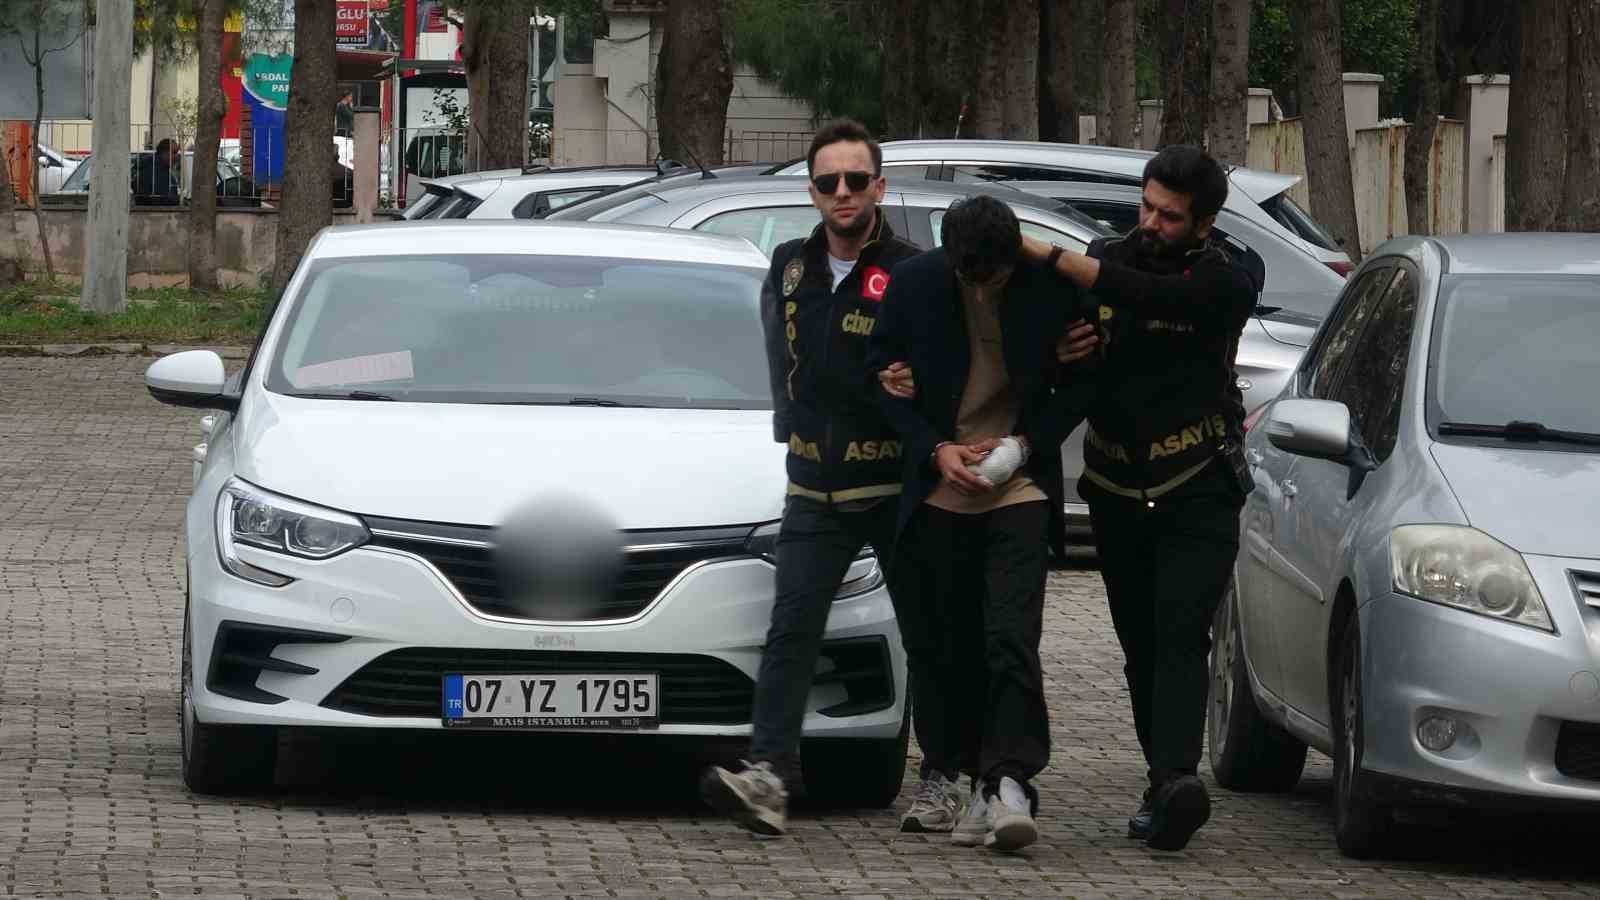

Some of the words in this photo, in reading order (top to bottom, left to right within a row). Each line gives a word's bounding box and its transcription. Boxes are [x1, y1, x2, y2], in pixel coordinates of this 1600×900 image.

[447, 699, 461, 709] TR
[465, 680, 502, 713] 07
[520, 680, 556, 713] YZ
[576, 679, 650, 713] 1795
